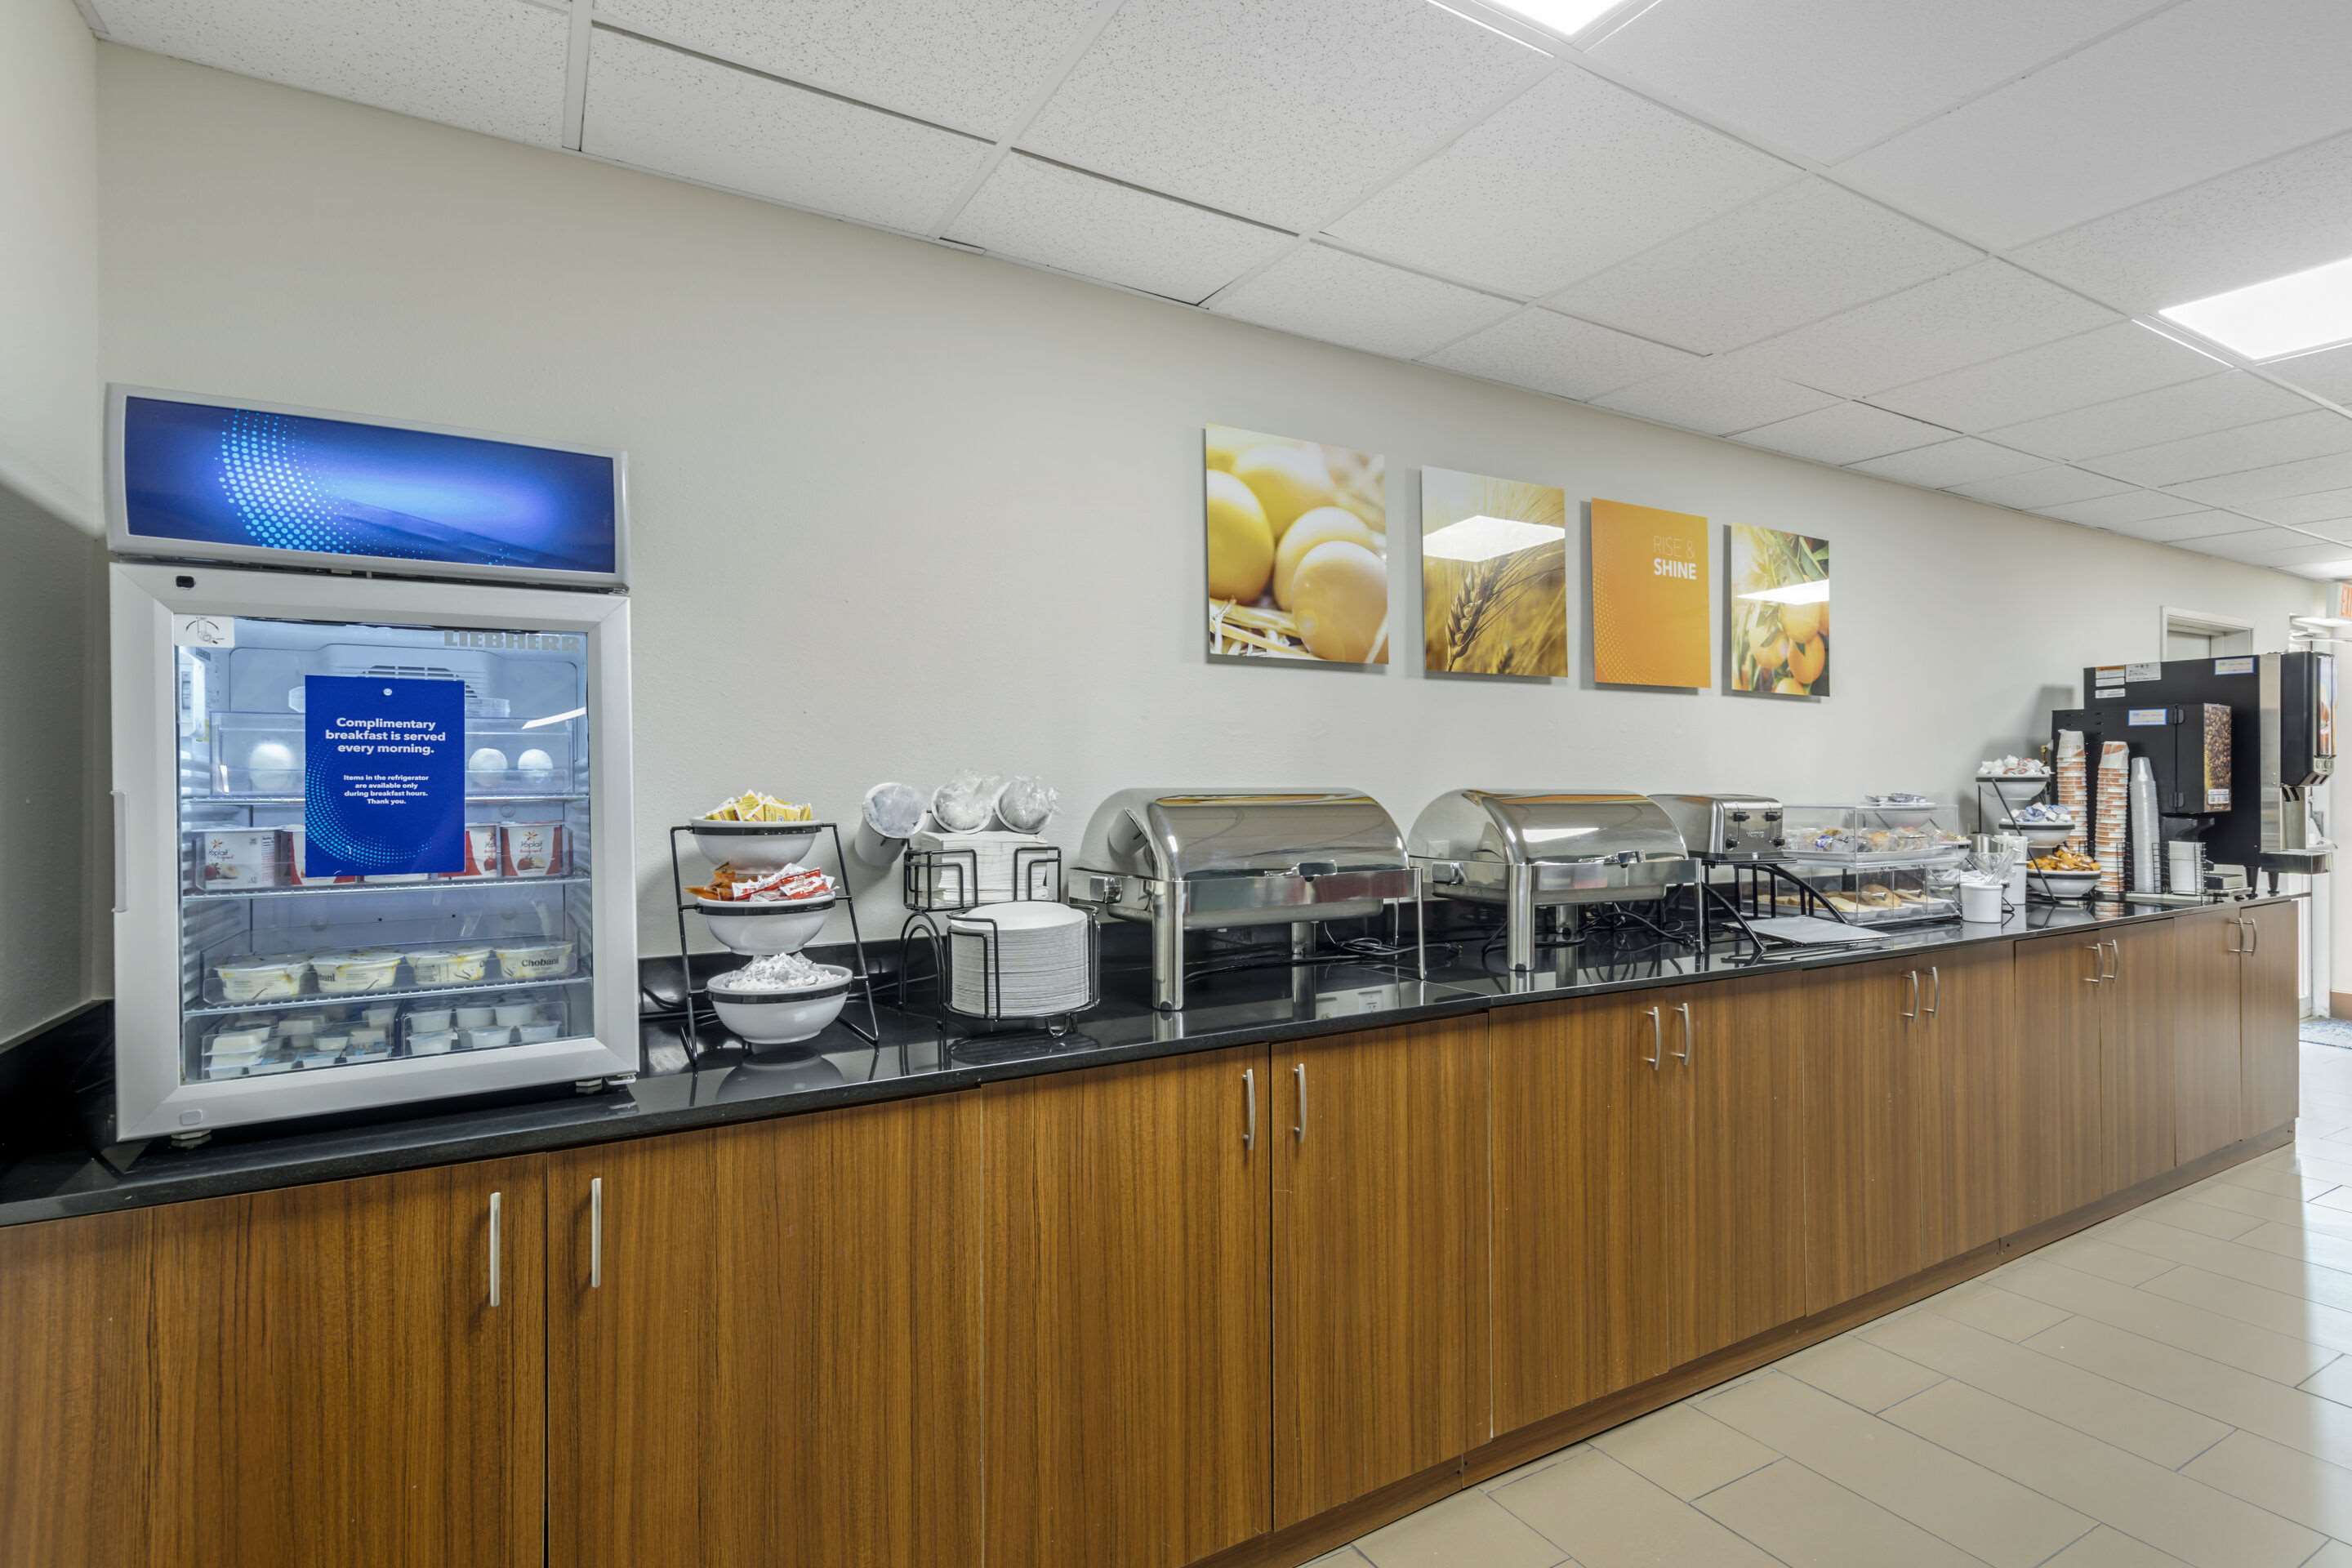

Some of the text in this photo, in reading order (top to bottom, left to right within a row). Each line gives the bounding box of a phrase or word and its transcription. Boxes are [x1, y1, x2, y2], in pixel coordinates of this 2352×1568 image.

[1653, 535, 1682, 557] RISE
[1654, 557, 1697, 580] SHINE
[444, 630, 581, 653] LIEBHERR
[336, 717, 436, 732] Complimentary
[325, 729, 446, 742] breakfast is served
[337, 743, 435, 756] every morning.
[387, 774, 430, 782] refrigerator
[344, 790, 369, 798] during
[521, 957, 559, 969] Chobani
